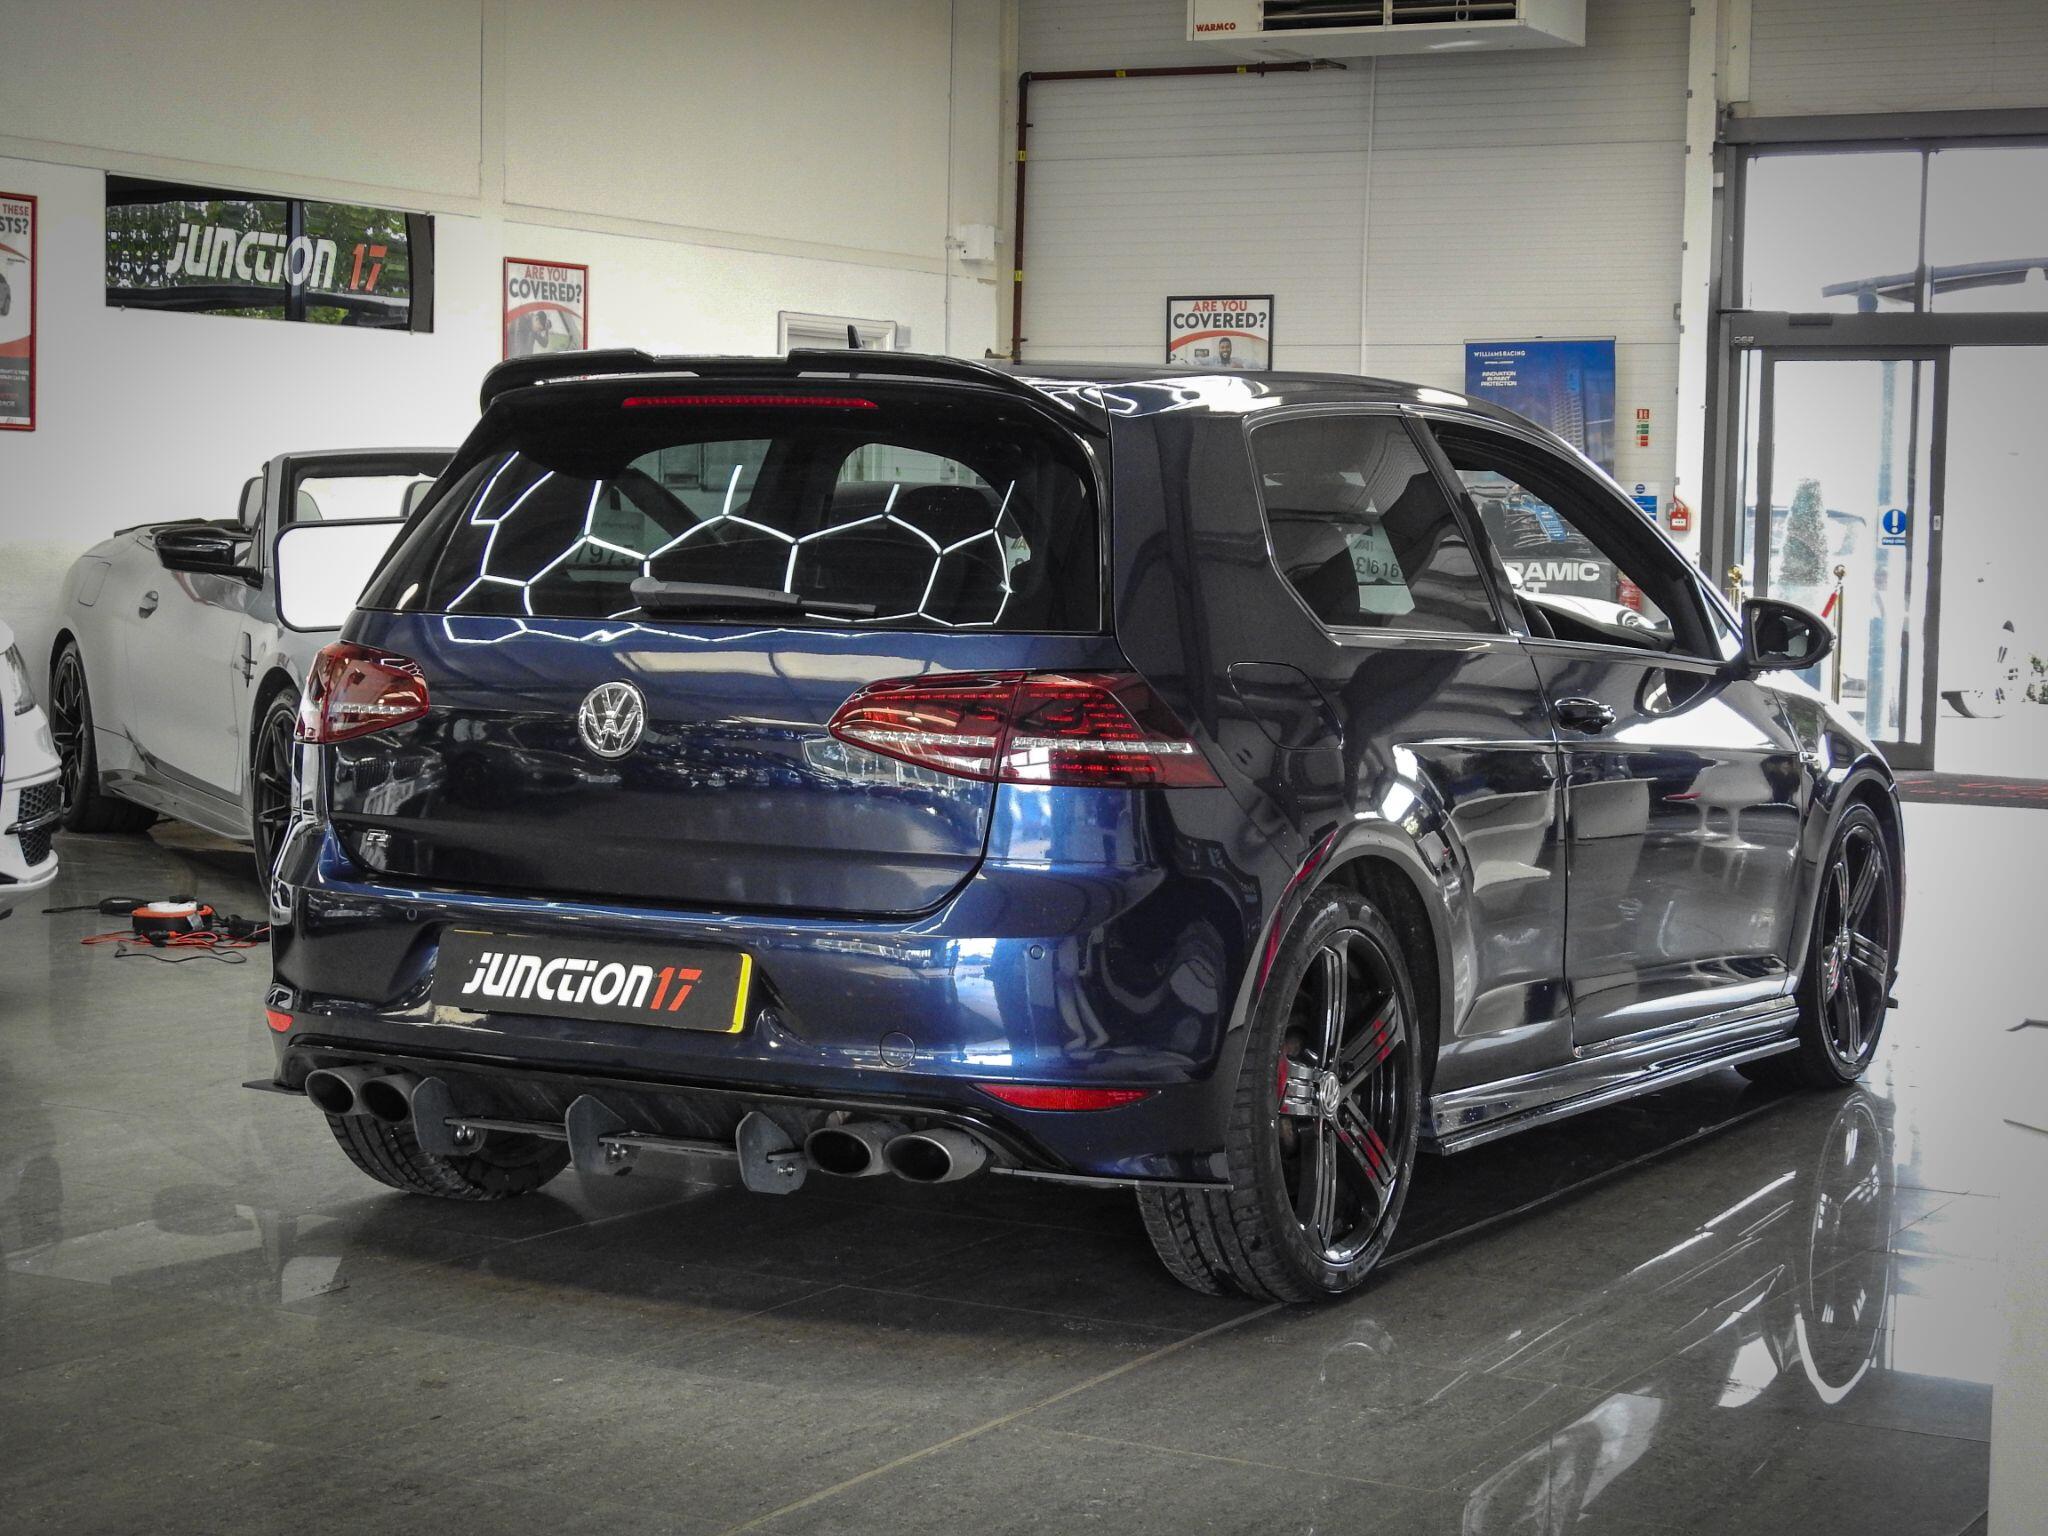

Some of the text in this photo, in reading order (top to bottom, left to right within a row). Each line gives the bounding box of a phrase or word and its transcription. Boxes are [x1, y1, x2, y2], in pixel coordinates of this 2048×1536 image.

[1196, 22, 1236, 32] WARMCO
[3, 203, 29, 216] THESE
[165, 222, 388, 292] JUNCTION 17
[525, 265, 568, 282] ARE YOU
[509, 278, 582, 303] COVERED?
[1192, 300, 1248, 312] ARE YOU
[1173, 311, 1267, 329] COVERED?
